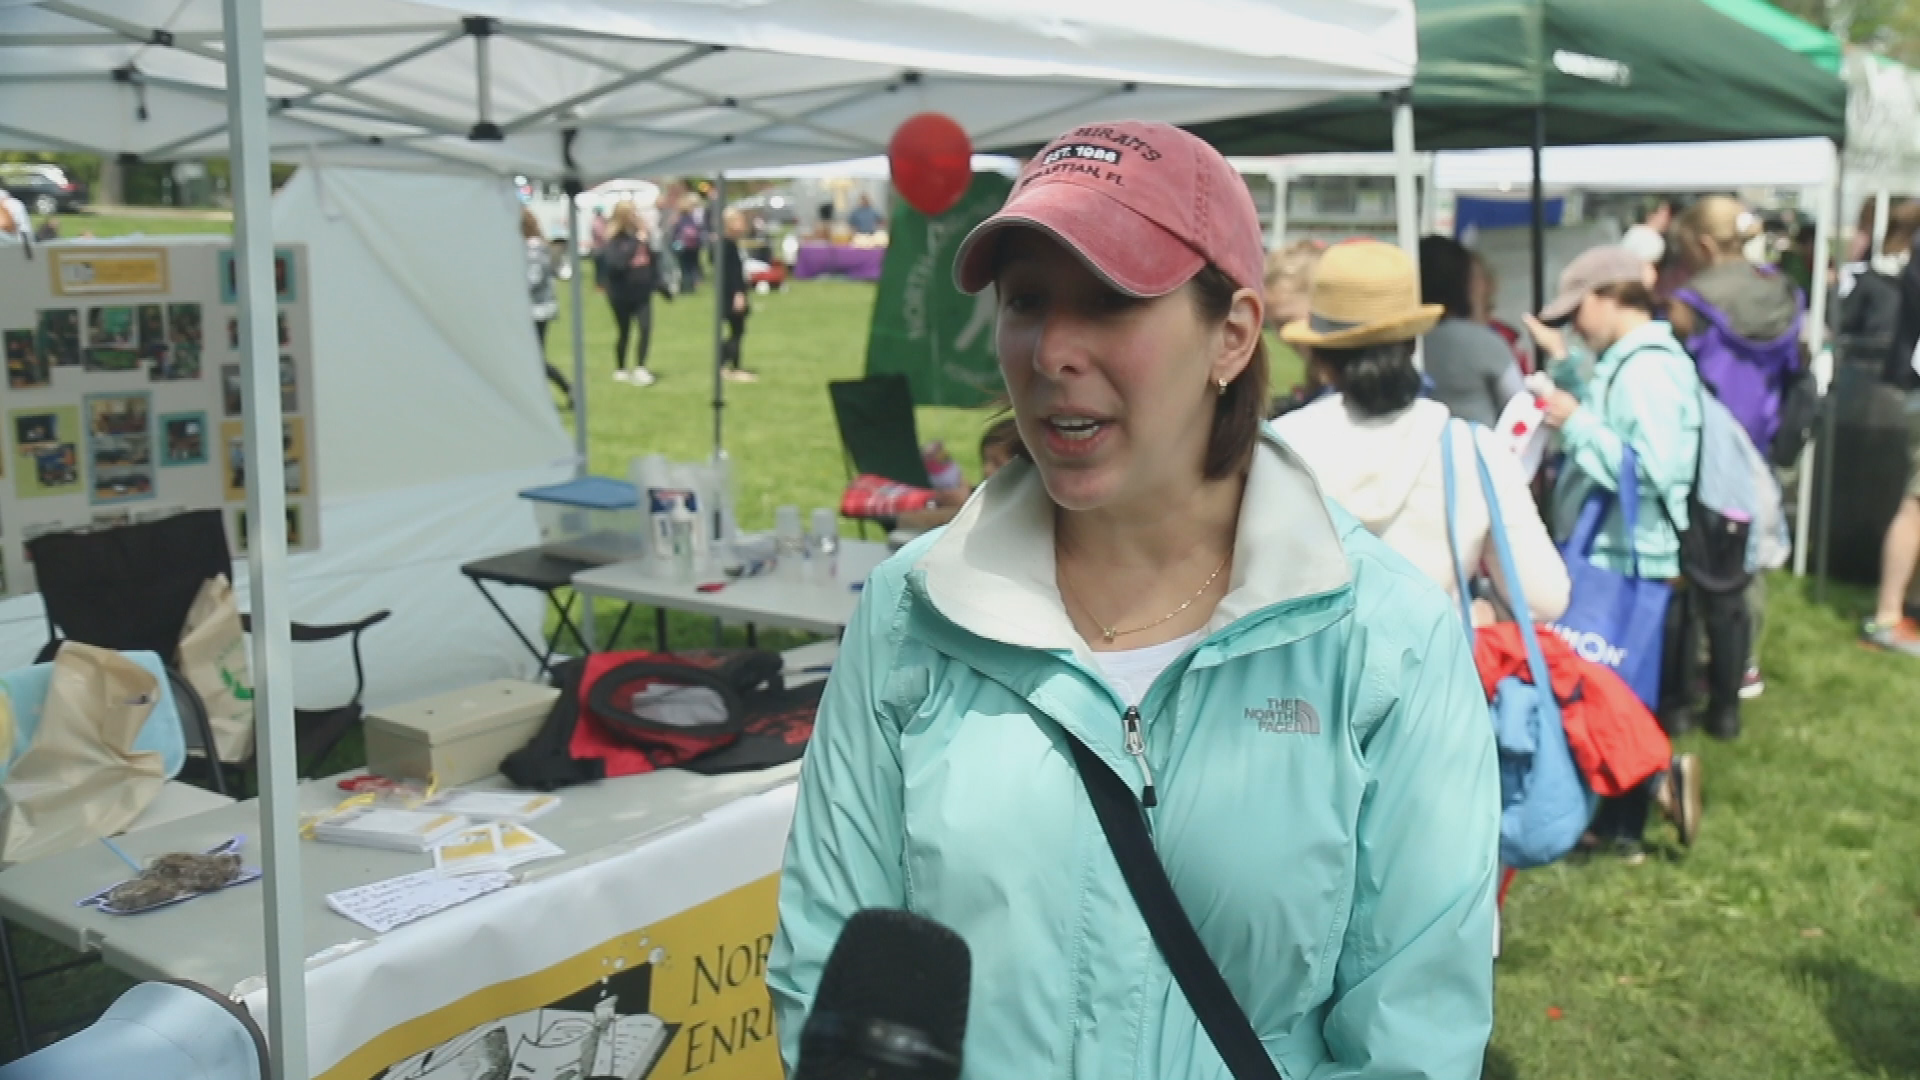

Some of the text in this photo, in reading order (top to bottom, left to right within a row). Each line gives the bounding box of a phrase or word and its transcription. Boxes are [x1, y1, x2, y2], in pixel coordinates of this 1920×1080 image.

[1266, 697, 1294, 709] THE
[1243, 707, 1294, 720] NORTH
[1258, 721, 1295, 734] FACE
